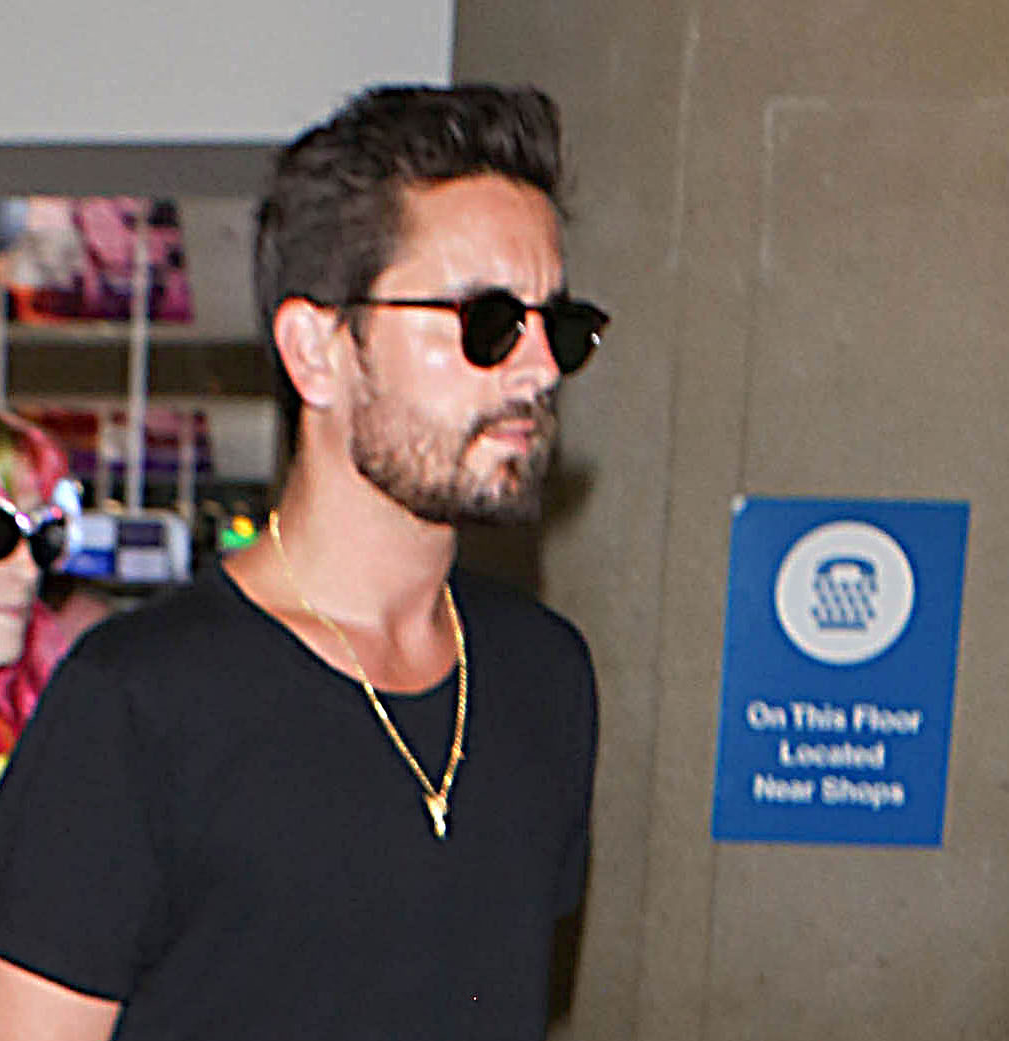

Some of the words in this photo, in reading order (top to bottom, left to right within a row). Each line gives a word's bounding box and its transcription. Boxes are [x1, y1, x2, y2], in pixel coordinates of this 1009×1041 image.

[747, 700, 787, 732] On
[792, 703, 847, 733] This
[853, 704, 922, 735] Floor
[780, 739, 885, 770] Located
[754, 774, 814, 803] Near
[821, 776, 905, 811] Shops
